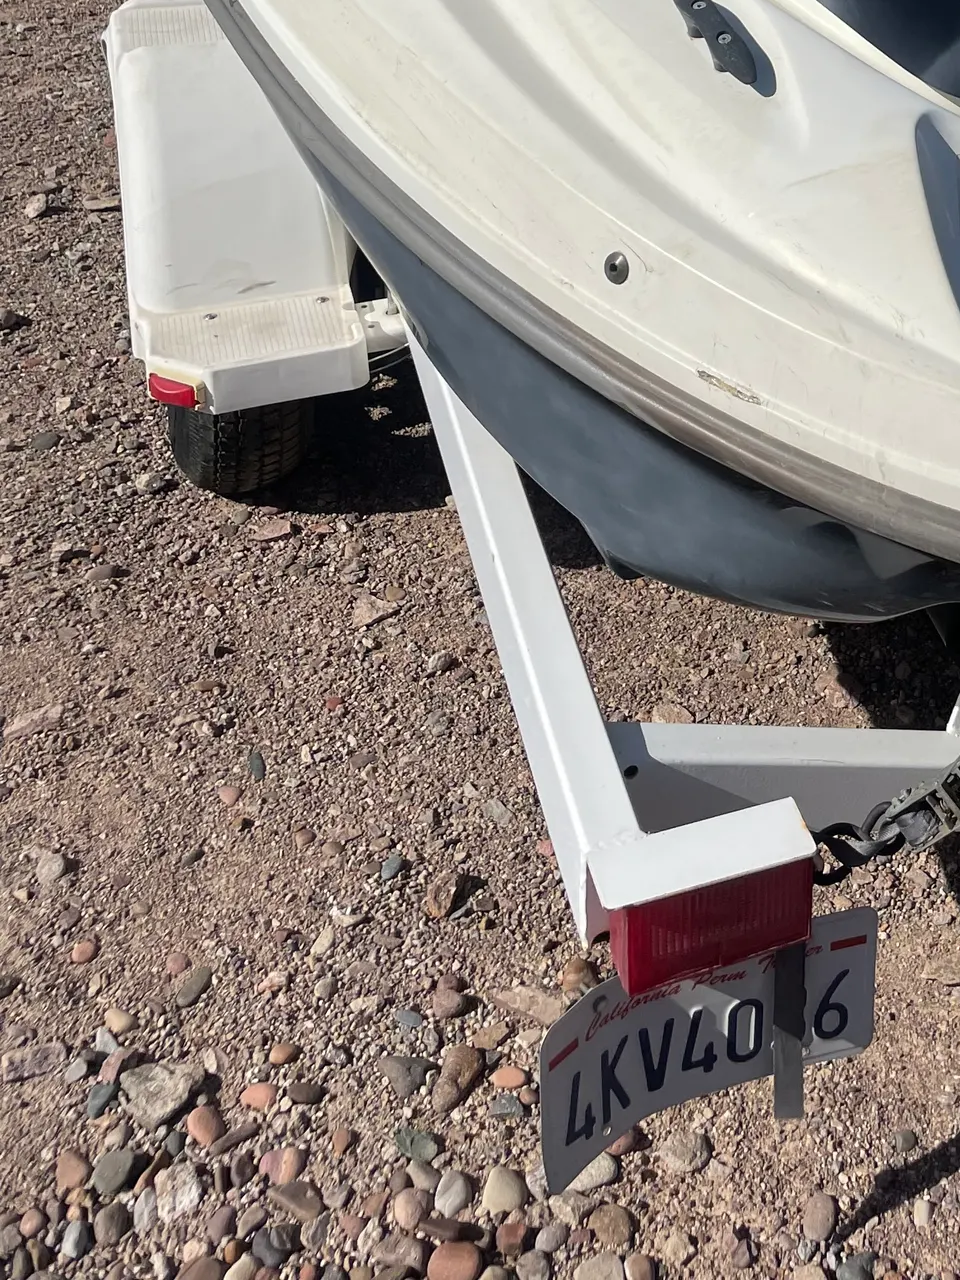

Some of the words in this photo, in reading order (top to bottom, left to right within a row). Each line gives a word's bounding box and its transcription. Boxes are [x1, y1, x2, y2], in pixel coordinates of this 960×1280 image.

[565, 968, 850, 1147] 4KV406
[584, 981, 682, 1042] California
[691, 969, 747, 991] Perm
